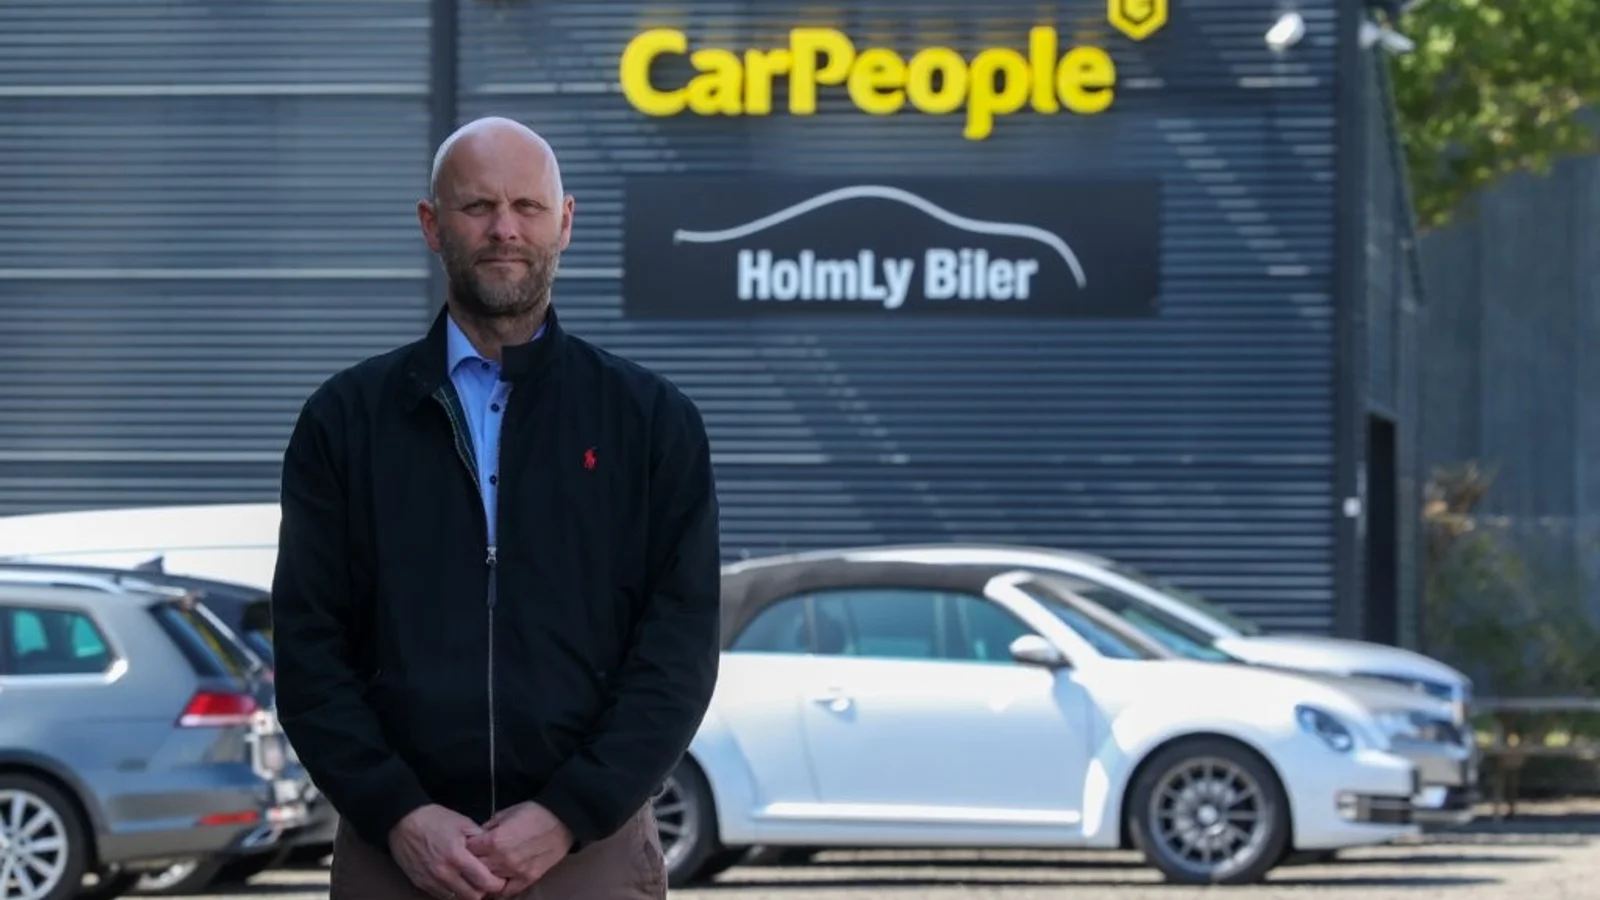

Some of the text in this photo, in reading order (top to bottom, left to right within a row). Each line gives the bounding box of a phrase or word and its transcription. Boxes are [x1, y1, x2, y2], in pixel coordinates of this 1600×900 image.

[620, 26, 1115, 139] CarPeople
[737, 248, 1038, 309] HolmLy Biler
